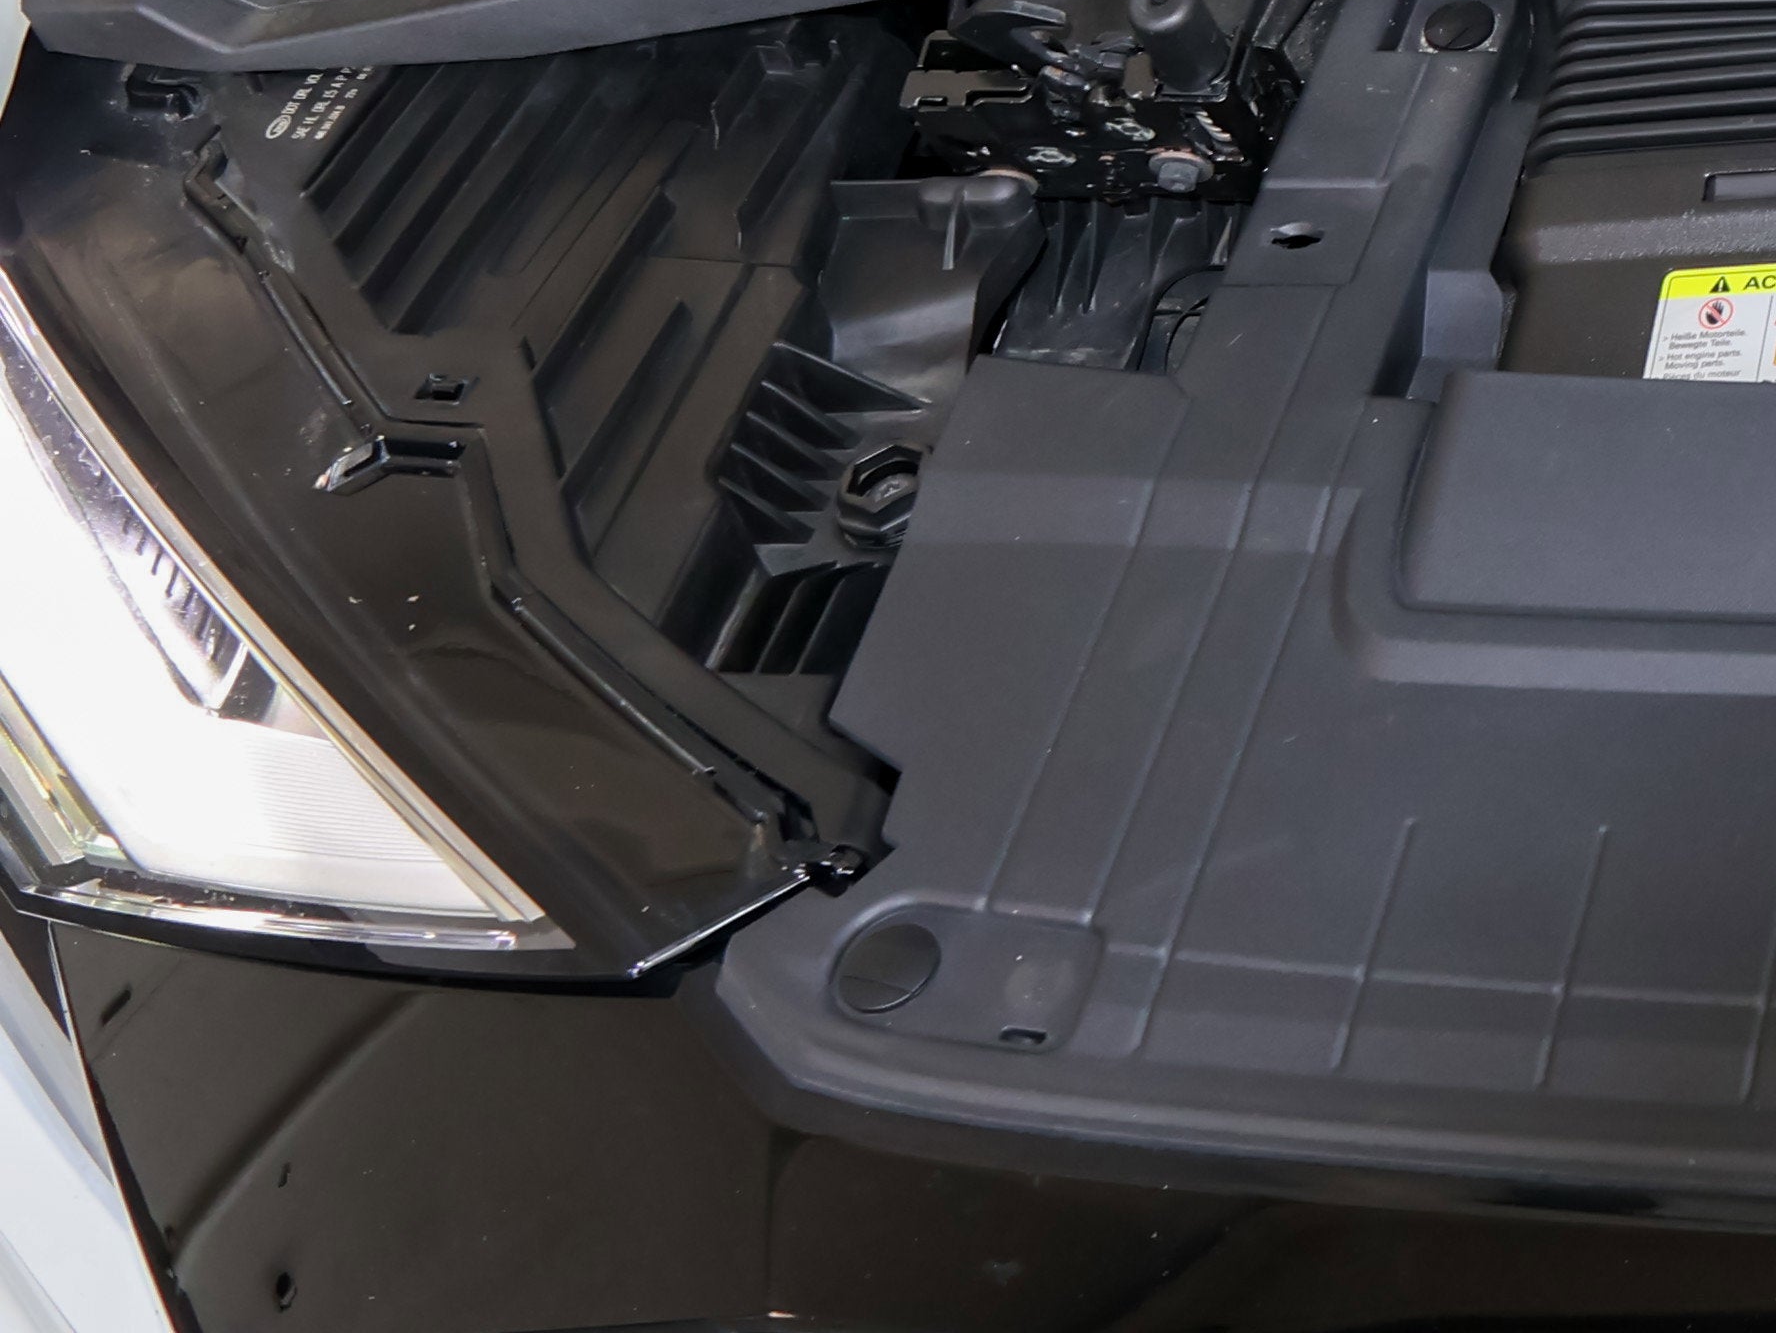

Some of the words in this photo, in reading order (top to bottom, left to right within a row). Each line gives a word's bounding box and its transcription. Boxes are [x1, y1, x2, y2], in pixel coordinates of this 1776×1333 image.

[1668, 341, 1708, 350] Bewegte
[1666, 353, 1682, 361] Hot
[1685, 352, 1715, 361] engine
[1665, 361, 1698, 370] Moving
[1694, 371, 1705, 379] du
